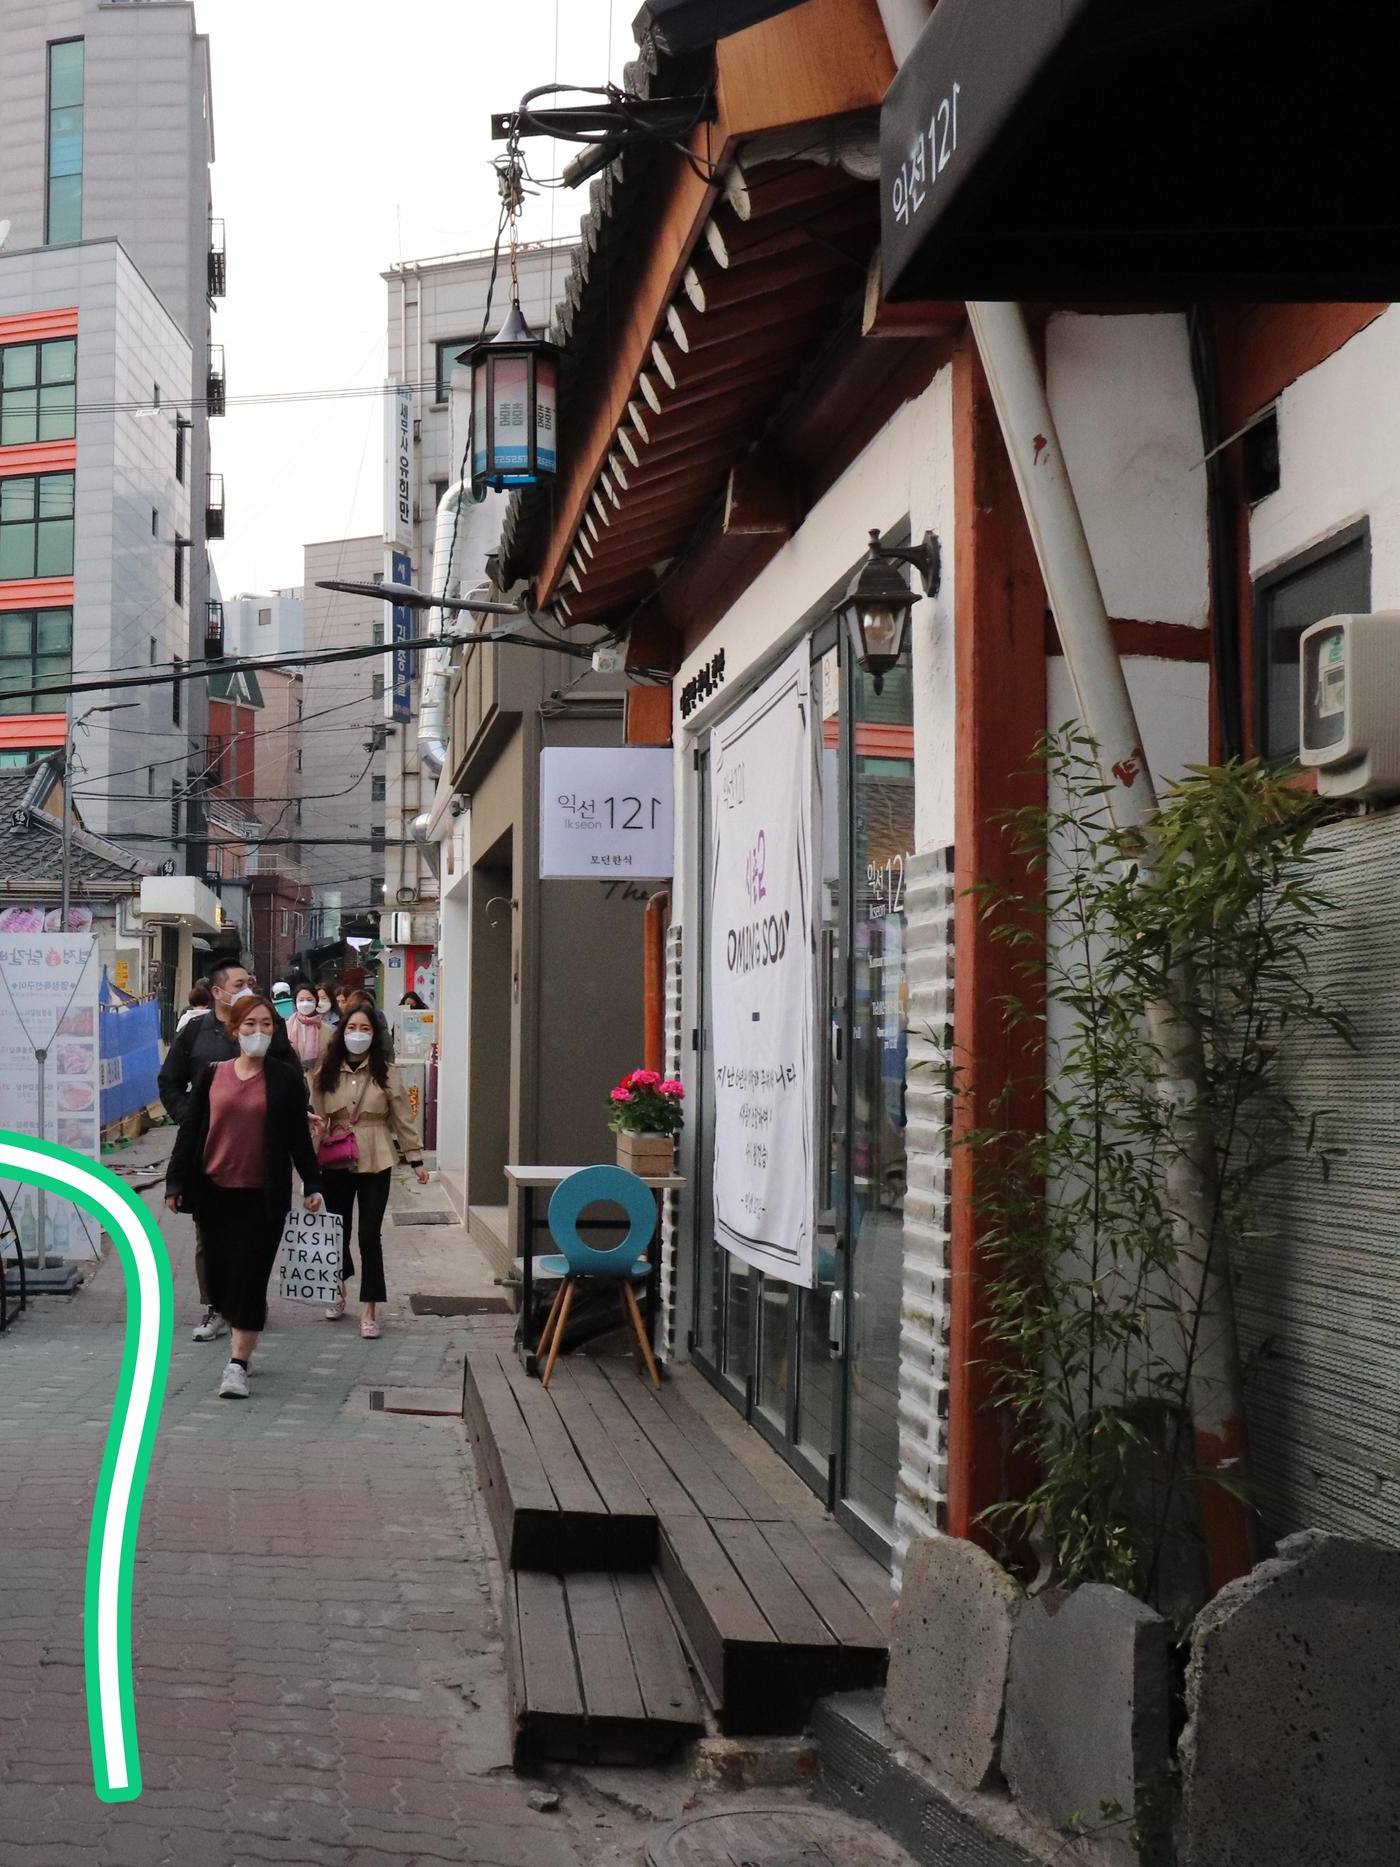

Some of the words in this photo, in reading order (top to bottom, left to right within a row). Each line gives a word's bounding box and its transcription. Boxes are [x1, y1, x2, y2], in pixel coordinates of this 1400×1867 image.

[892, 132, 926, 225] 익선
[928, 81, 961, 184] 121
[557, 794, 596, 820] 익선
[603, 796, 662, 830] 121
[589, 855, 633, 866] 모던한식
